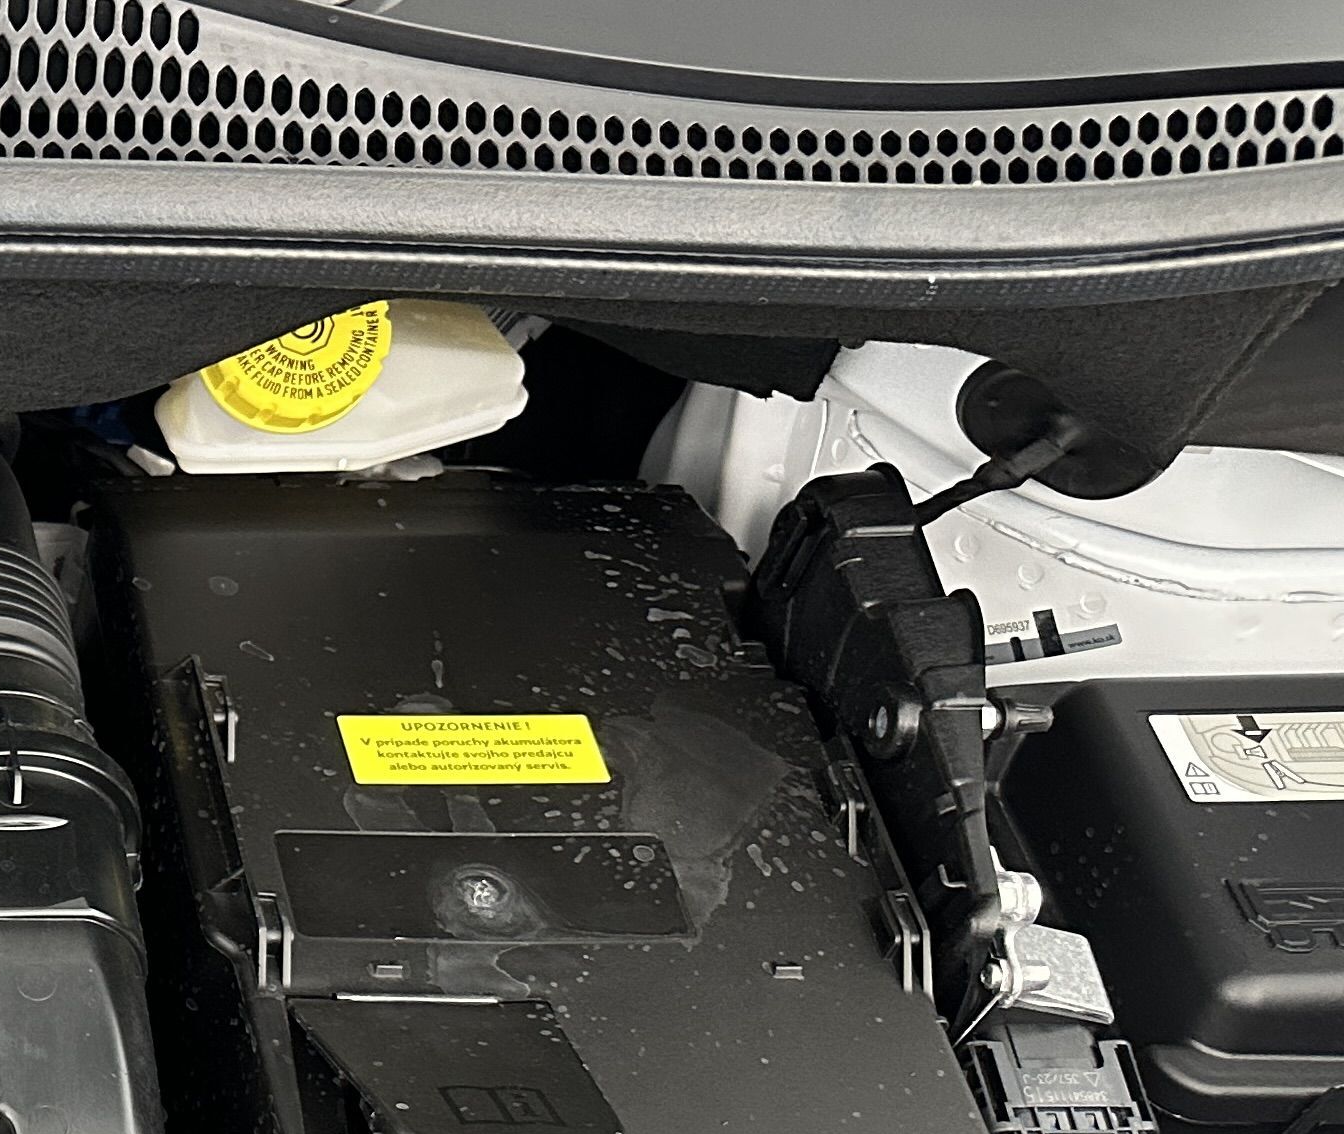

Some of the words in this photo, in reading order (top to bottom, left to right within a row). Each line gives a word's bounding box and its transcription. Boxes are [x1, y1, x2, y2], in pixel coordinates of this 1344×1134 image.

[251, 370, 282, 395] FLUID
[282, 386, 313, 400] FROM
[316, 386, 325, 399] A
[326, 368, 362, 396] SEALED
[356, 309, 380, 368] CONTAINER
[262, 358, 283, 378] CAP
[282, 371, 326, 386] BEFORE
[325, 329, 365, 378] REMOVING
[265, 344, 315, 371] WARNING
[360, 738, 370, 746] V
[432, 739, 489, 748] poruchy
[493, 737, 582, 746] akumulátora
[377, 750, 459, 759] kontaktujte
[463, 750, 509, 760] svojho
[389, 762, 427, 771] alebo
[431, 762, 522, 772] autorizovaný
[526, 762, 571, 771] servis.
